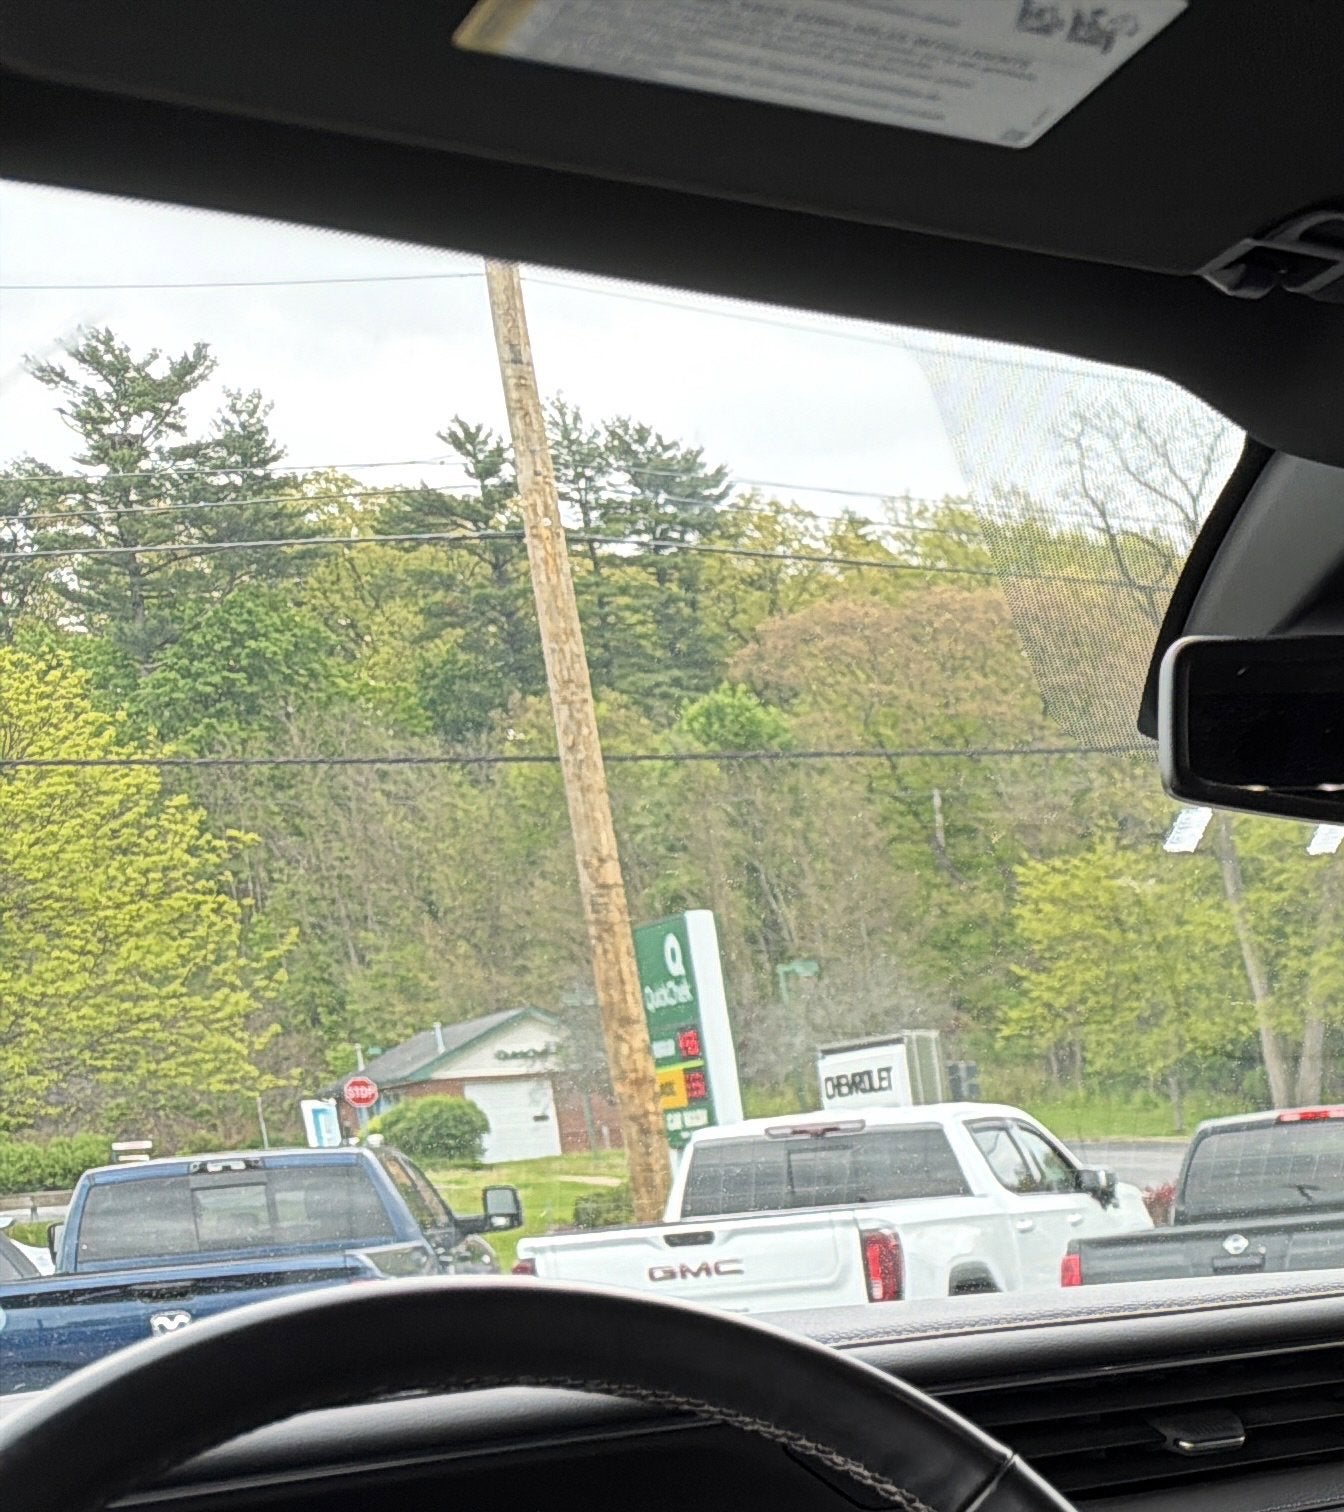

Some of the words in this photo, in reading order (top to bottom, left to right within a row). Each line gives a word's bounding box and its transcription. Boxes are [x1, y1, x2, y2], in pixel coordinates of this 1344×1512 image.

[664, 933, 686, 977] Q
[347, 1085, 376, 1100] STOP
[824, 1066, 893, 1100] CHEVROLET
[648, 1258, 745, 1282] GMC
